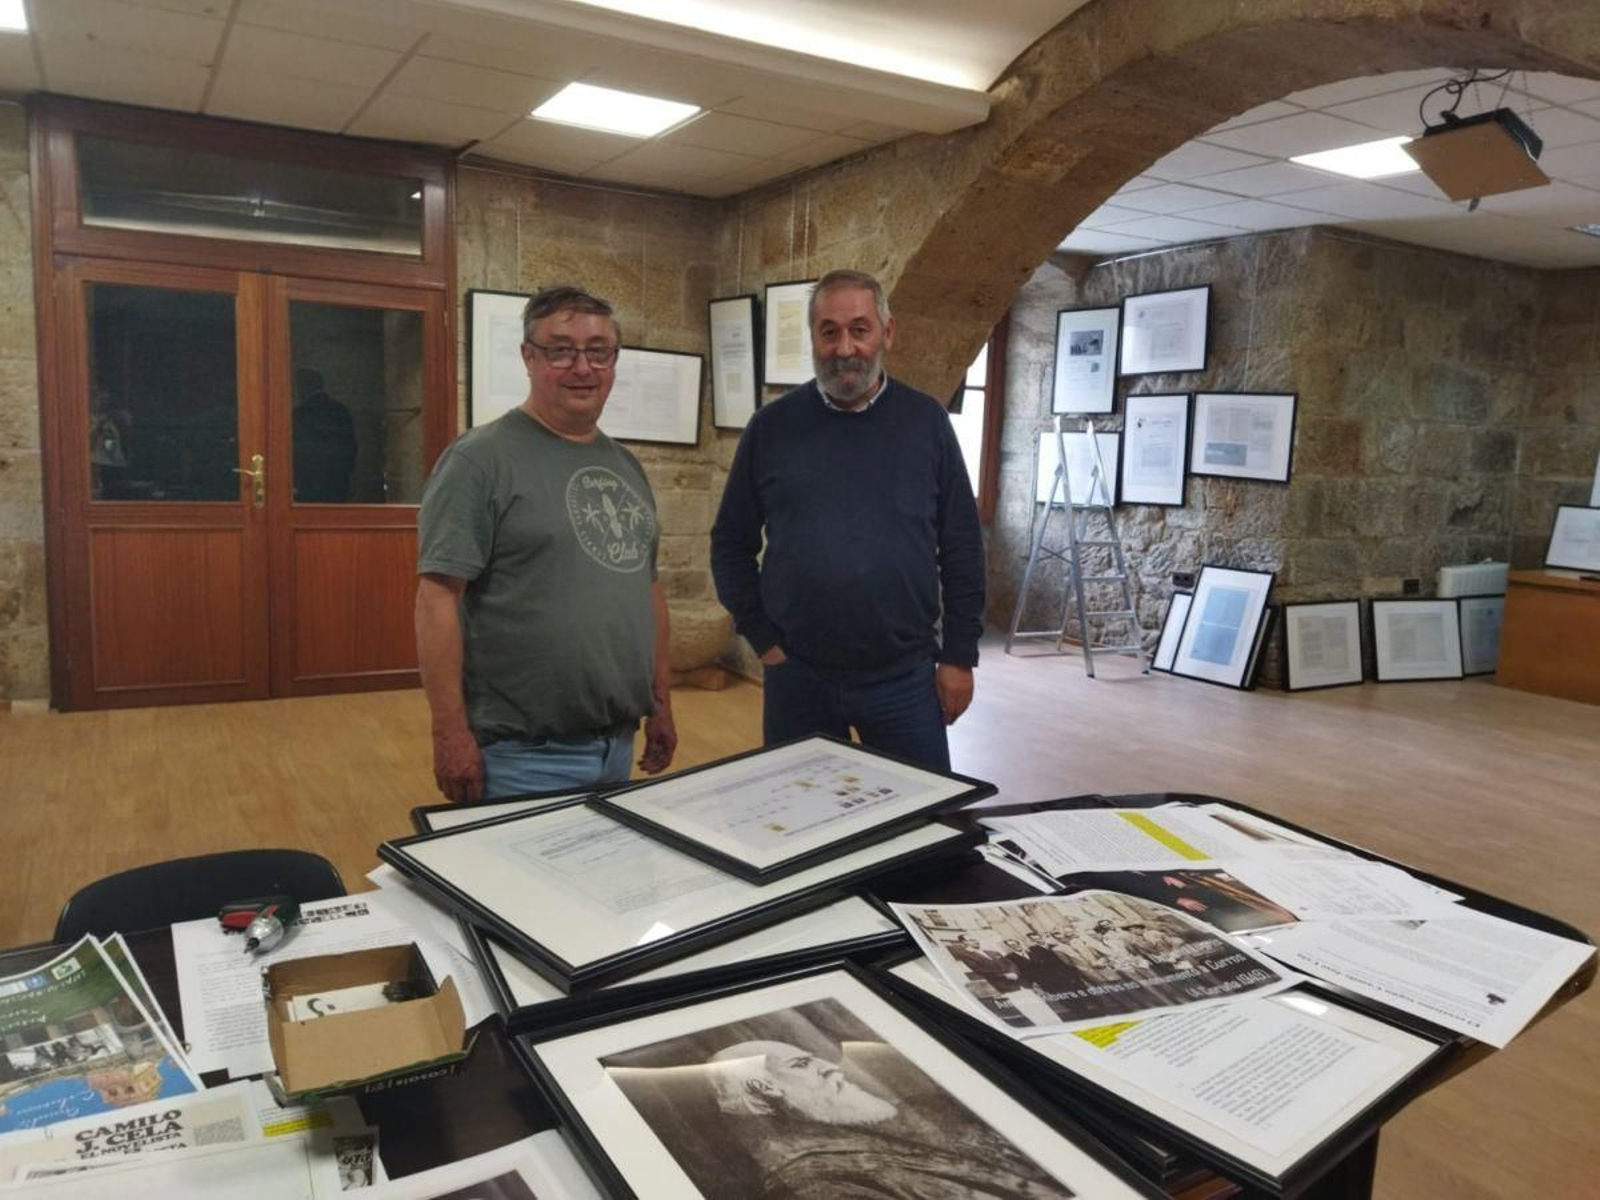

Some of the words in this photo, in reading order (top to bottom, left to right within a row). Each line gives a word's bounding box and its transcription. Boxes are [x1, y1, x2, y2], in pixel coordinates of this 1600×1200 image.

[607, 541, 639, 563] Club
[75, 1109, 182, 1142] CAMILO
[75, 1140, 99, 1154] J.
[106, 1121, 184, 1146] CELA
[101, 1131, 182, 1155] NOVELISTA
